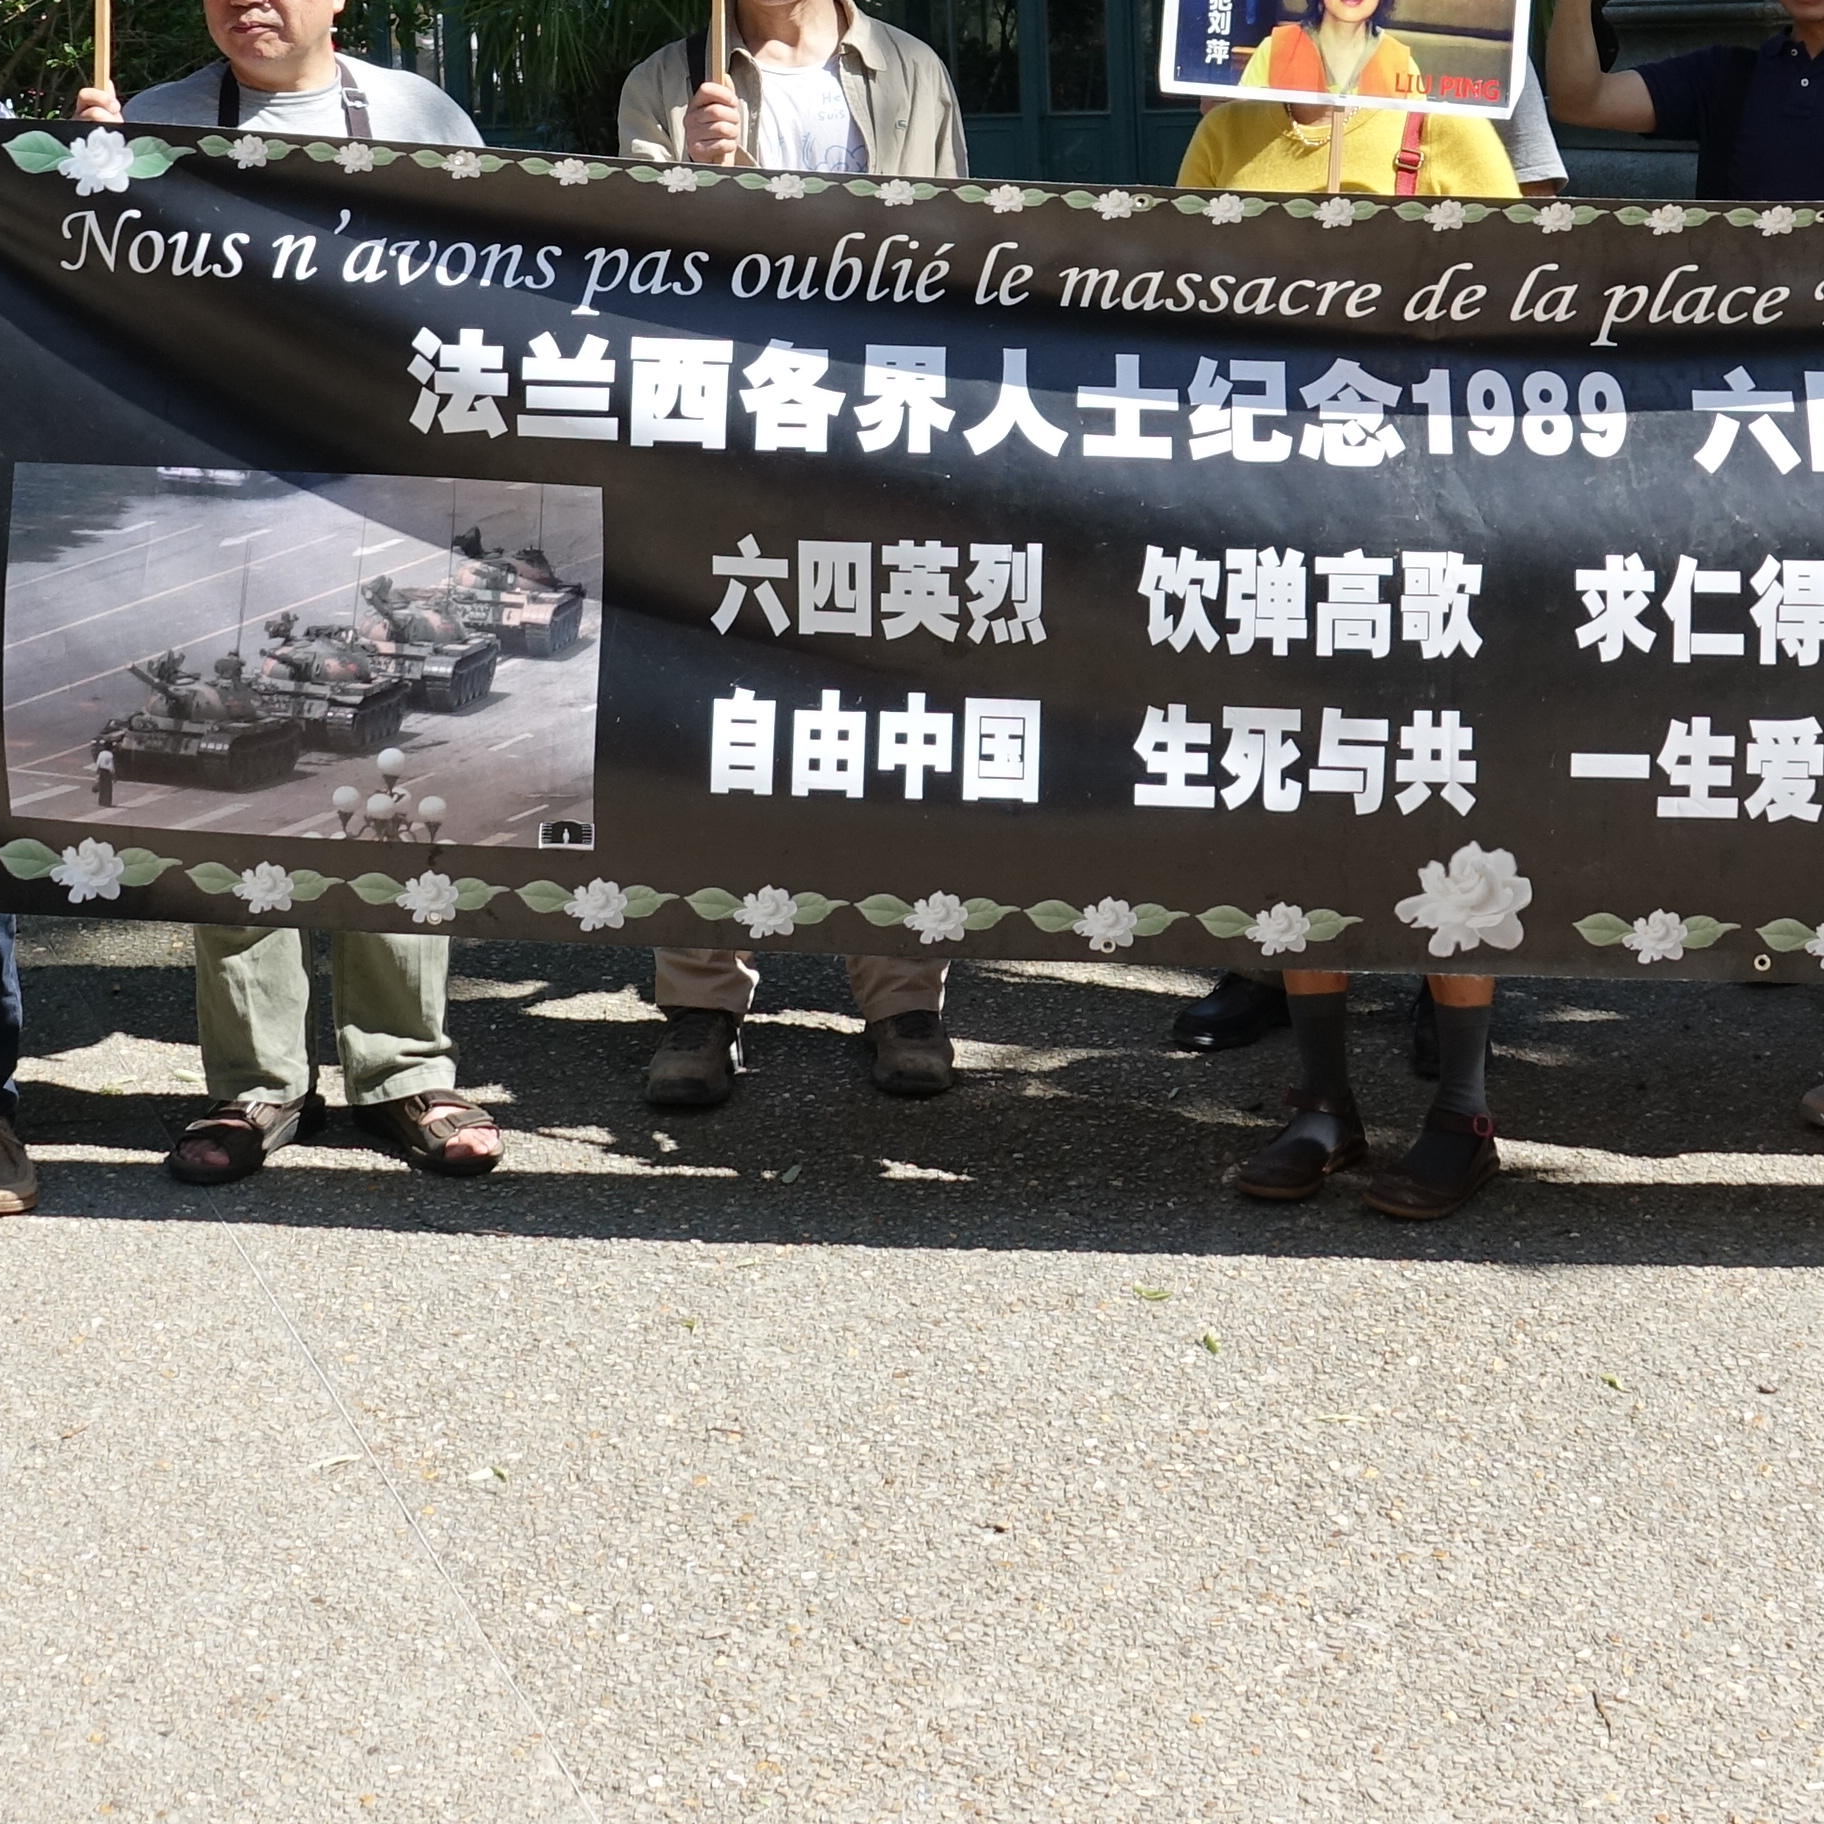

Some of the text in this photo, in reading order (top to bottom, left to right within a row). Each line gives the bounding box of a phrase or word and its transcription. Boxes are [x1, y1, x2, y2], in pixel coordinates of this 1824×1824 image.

[1395, 73, 1500, 102] LIU PING
[59, 209, 250, 278] Nous
[271, 209, 563, 289] n'avons
[571, 245, 710, 316] pas
[731, 231, 955, 304] oublié
[974, 241, 1033, 306] le
[1059, 262, 1382, 318] massacre
[1404, 262, 1487, 322] de
[1509, 262, 1578, 324] la
[1589, 264, 1790, 347] place
[407, 326, 1628, 468] 法兰西各界人士纪念1989
[710, 533, 1046, 646] 六四英烈
[1136, 543, 1484, 660] 饮弹高歌
[709, 686, 1042, 804] 自由中国
[1132, 702, 1479, 818] 生死与共
